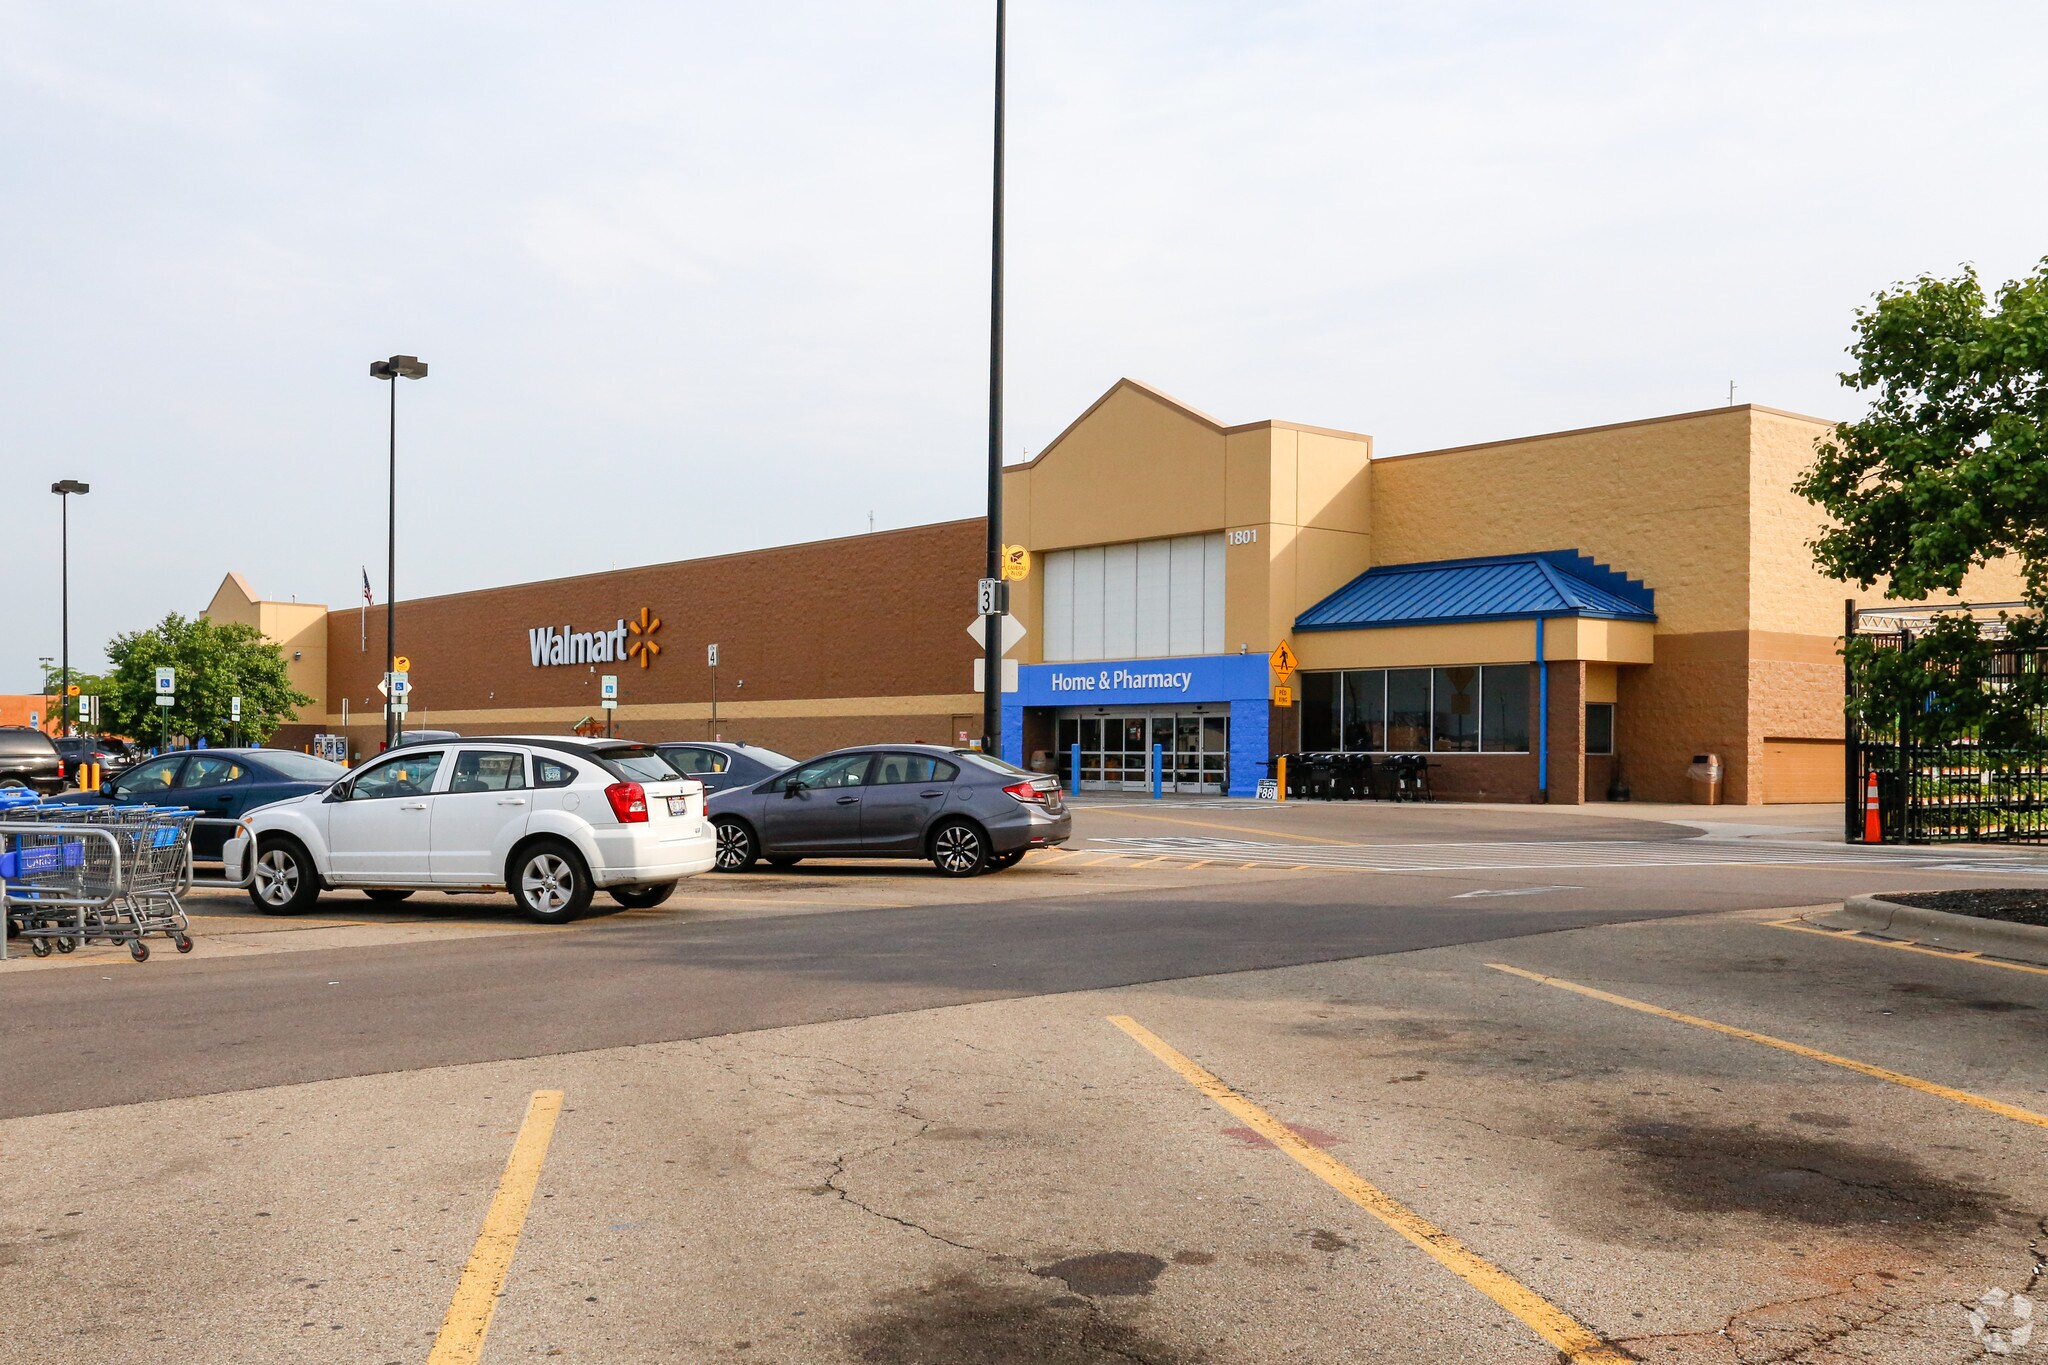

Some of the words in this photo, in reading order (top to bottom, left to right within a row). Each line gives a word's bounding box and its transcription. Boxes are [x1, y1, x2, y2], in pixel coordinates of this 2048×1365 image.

[1228, 529, 1257, 545] 1801
[982, 590, 990, 612] 3
[529, 619, 627, 667] Walmart
[710, 651, 715, 663] 4
[1052, 673, 1095, 691] Home
[1098, 671, 1110, 690] &
[1113, 669, 1192, 692] Pharmacy
